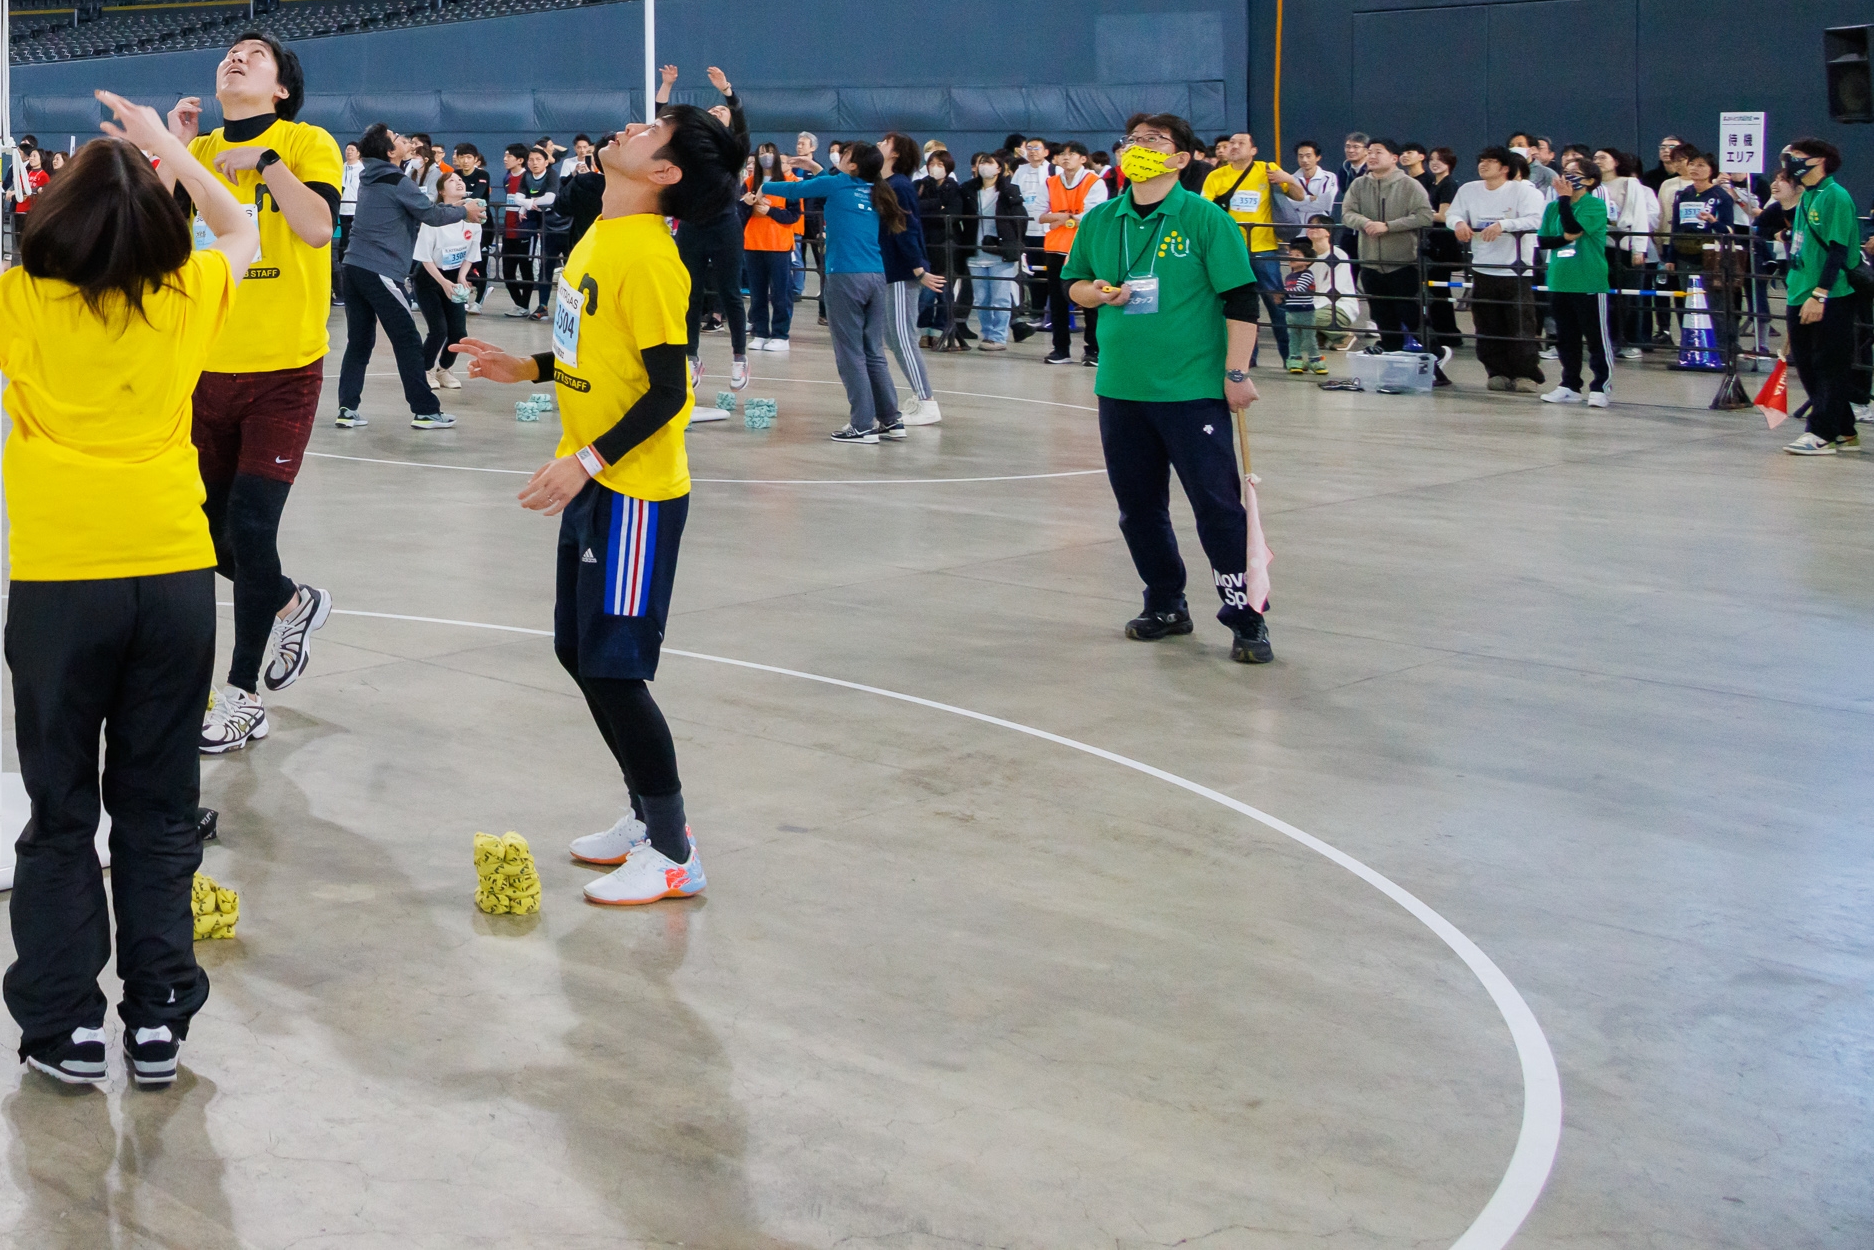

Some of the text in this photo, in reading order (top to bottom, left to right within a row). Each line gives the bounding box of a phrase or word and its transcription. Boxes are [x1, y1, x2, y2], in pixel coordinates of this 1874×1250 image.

[1728, 133, 1753, 147] 待機
[1726, 151, 1755, 163] エリア
[1239, 197, 1258, 205] 3575
[250, 269, 278, 278] STAFF
